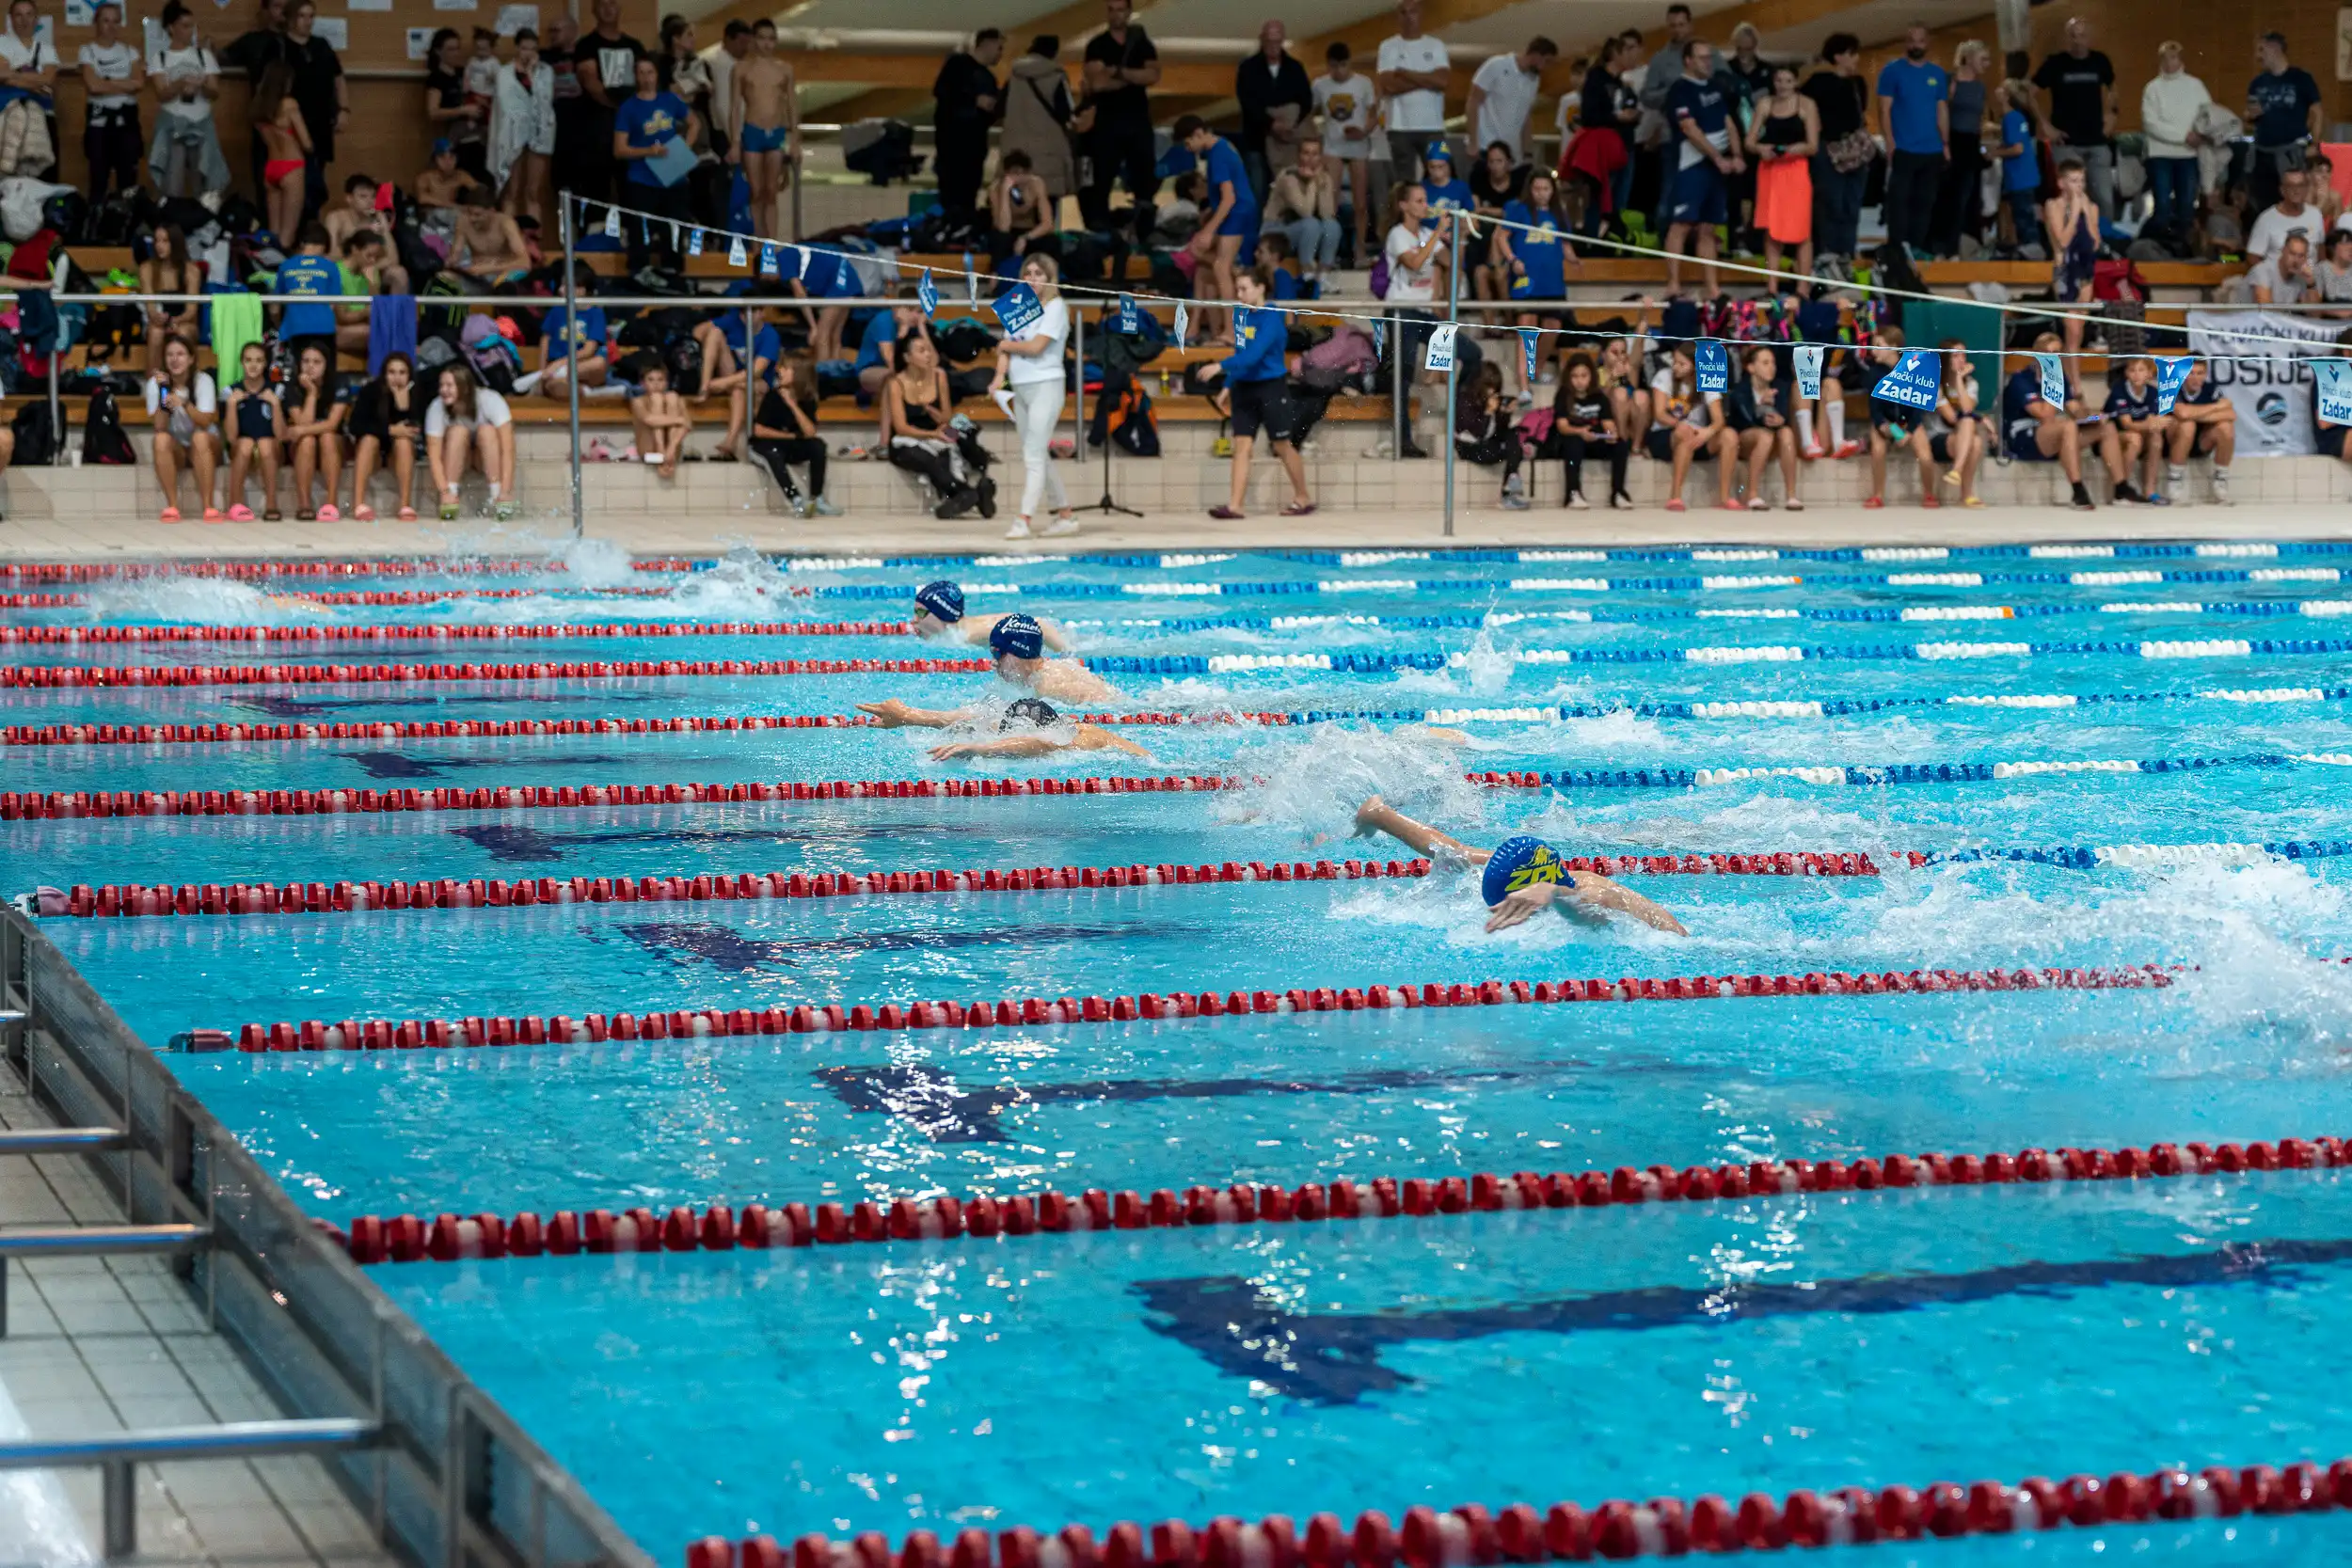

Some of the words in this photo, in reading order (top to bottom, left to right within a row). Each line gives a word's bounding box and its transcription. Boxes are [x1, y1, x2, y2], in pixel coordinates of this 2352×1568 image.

[1008, 306, 1041, 331] Zadar
[1429, 354, 1451, 368] Zadar
[1716, 362, 1726, 372] klub
[2210, 353, 2313, 386] OSIJE
[1700, 373, 1726, 388] Zadar
[1915, 374, 1935, 388] klub
[1878, 379, 1933, 406] Zadar
[2322, 398, 2352, 420] Zadar
